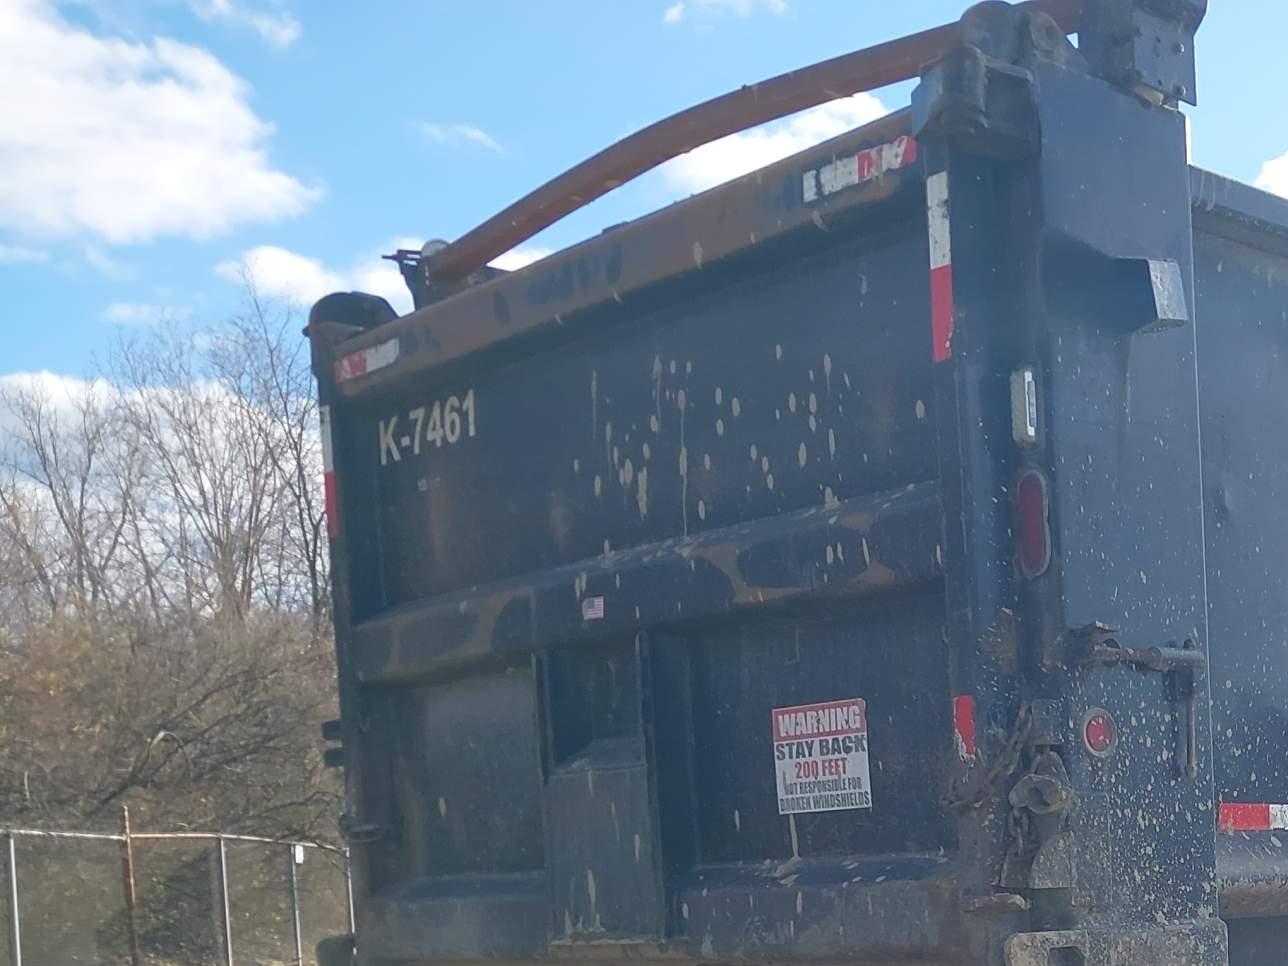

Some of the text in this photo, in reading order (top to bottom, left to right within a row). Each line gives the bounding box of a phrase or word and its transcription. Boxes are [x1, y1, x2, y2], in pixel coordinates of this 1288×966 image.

[379, 388, 475, 465] K-7461
[778, 705, 861, 737] WARNING
[775, 734, 866, 761] STAY BACK
[795, 758, 847, 780] 200 FEET
[799, 778, 847, 795] RESPONSIBLE
[848, 776, 862, 790] FOR
[812, 791, 870, 809] WINDSHIELDS
